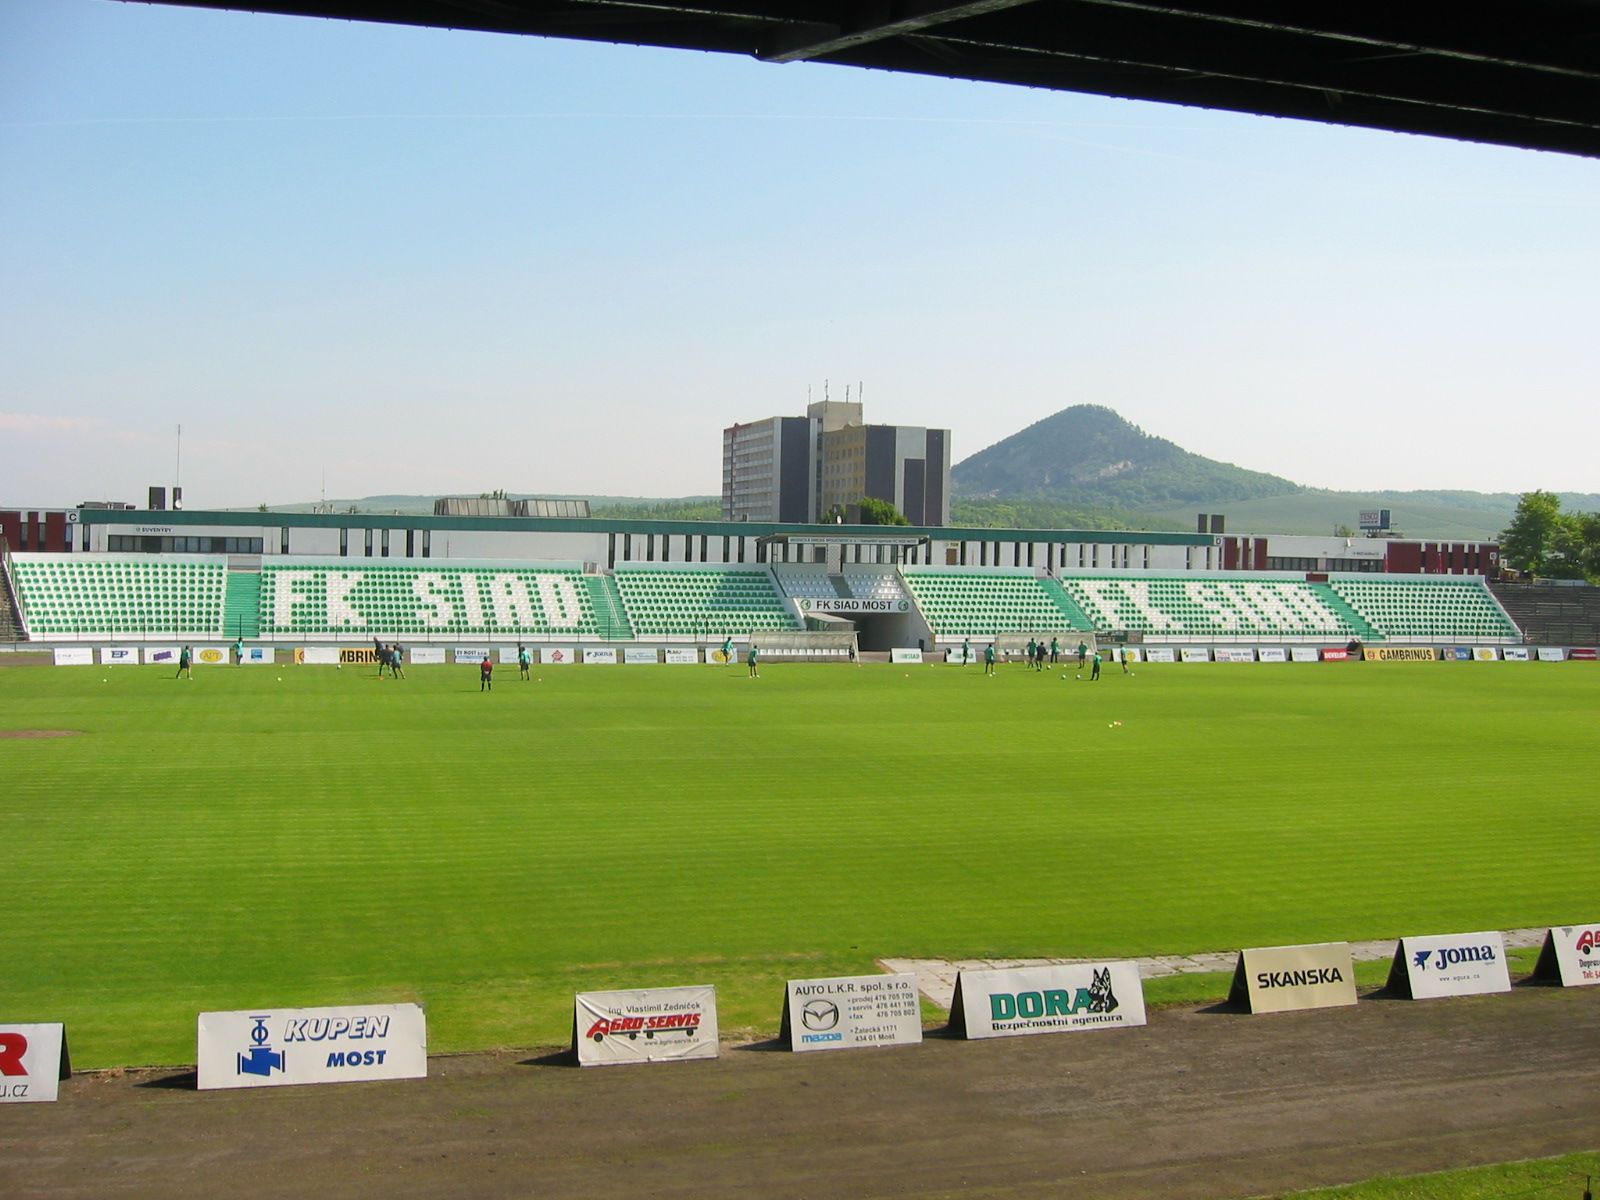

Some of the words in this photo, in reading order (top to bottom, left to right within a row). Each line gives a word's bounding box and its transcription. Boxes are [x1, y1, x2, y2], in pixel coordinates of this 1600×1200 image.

[816, 601, 830, 610] FK
[833, 601, 859, 610] SIAD
[862, 601, 892, 610] MOST
[1379, 650, 1433, 661] GAMBRINUS
[1257, 967, 1343, 989] SKANSKA
[796, 986, 825, 996] AUTO
[828, 983, 857, 994] L.K.R.
[861, 982, 884, 993] spol.
[626, 1004, 661, 1013] Vlastimil
[990, 988, 1097, 1020] DORA
[1072, 1015, 1122, 1025] agentura
[284, 1015, 390, 1042] KUPEN
[802, 1033, 842, 1043] mazda
[326, 1050, 387, 1068] MOST
